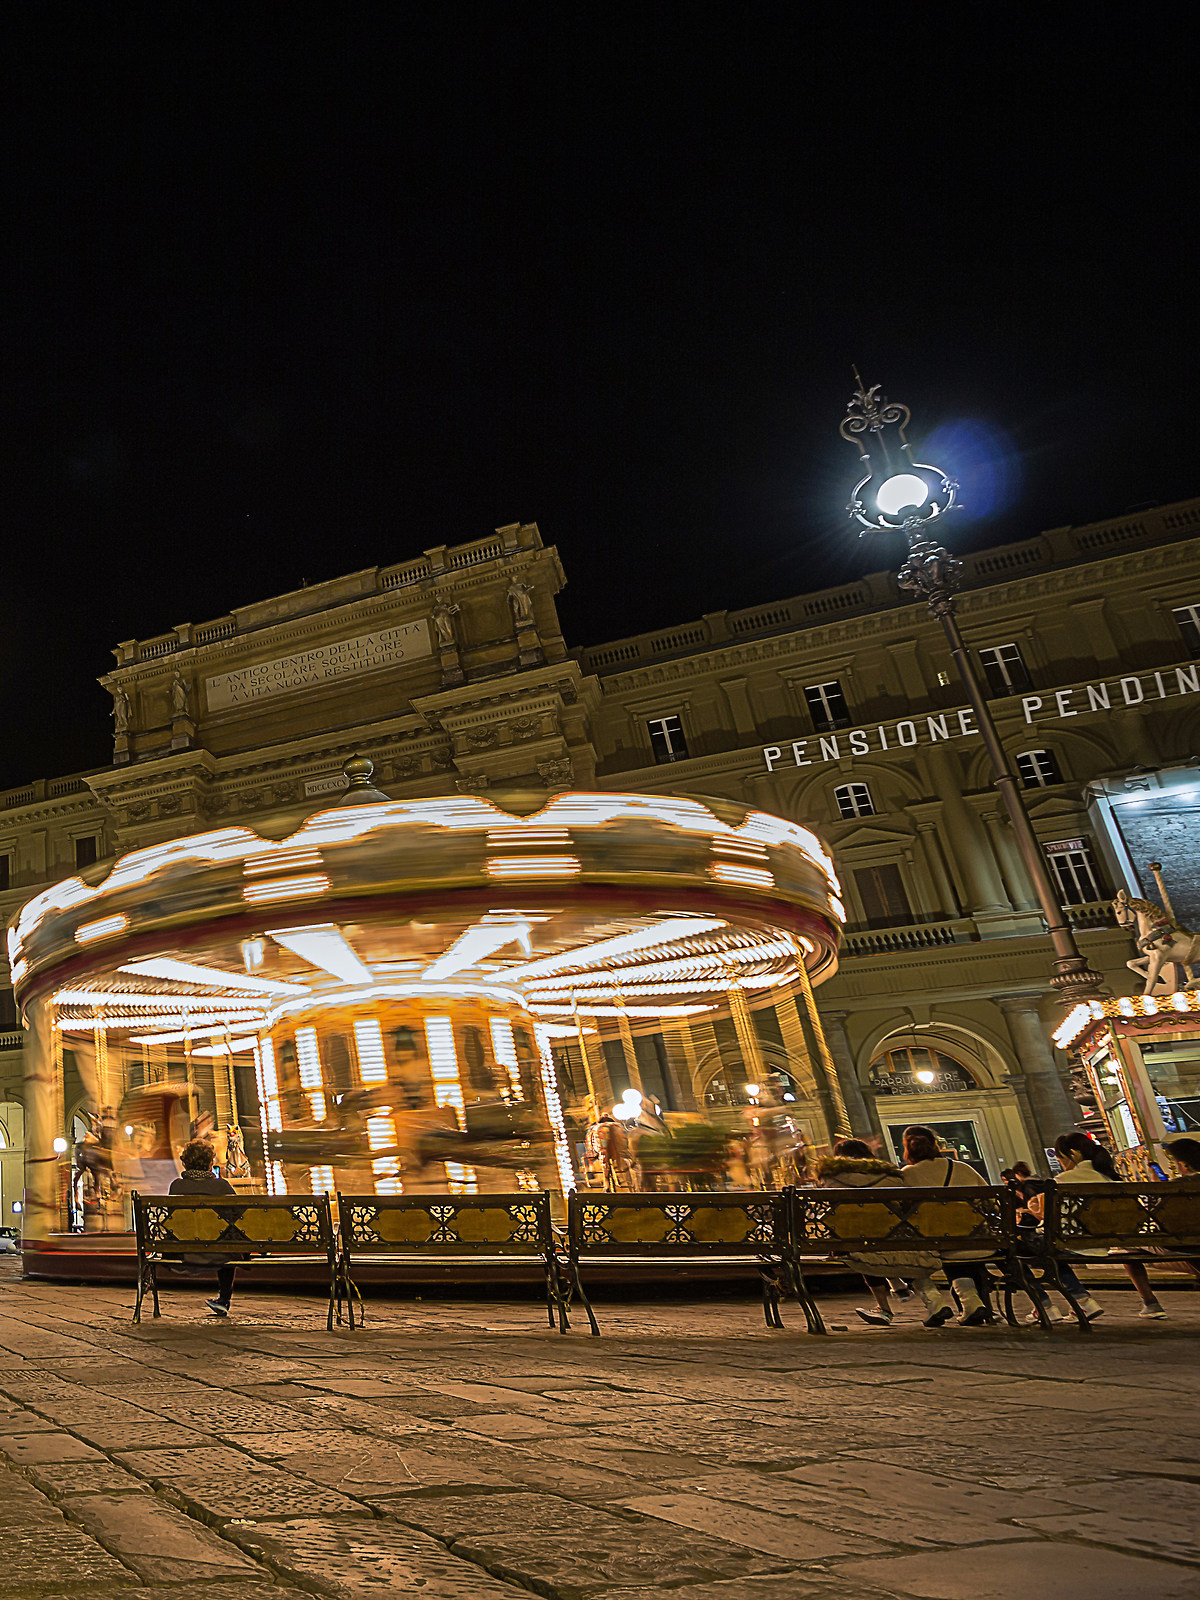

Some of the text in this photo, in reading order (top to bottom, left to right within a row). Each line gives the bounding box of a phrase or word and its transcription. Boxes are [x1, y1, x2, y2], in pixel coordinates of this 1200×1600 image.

[226, 665, 269, 684] ANTICO
[273, 651, 324, 671] CENTRO
[329, 637, 374, 656] DELLA
[230, 640, 403, 693] DA SECOLARE SQUALLORE
[232, 650, 404, 702] A VITA NUOVA RESTITUITO
[763, 665, 1200, 771] PENSIONE PENDIN
